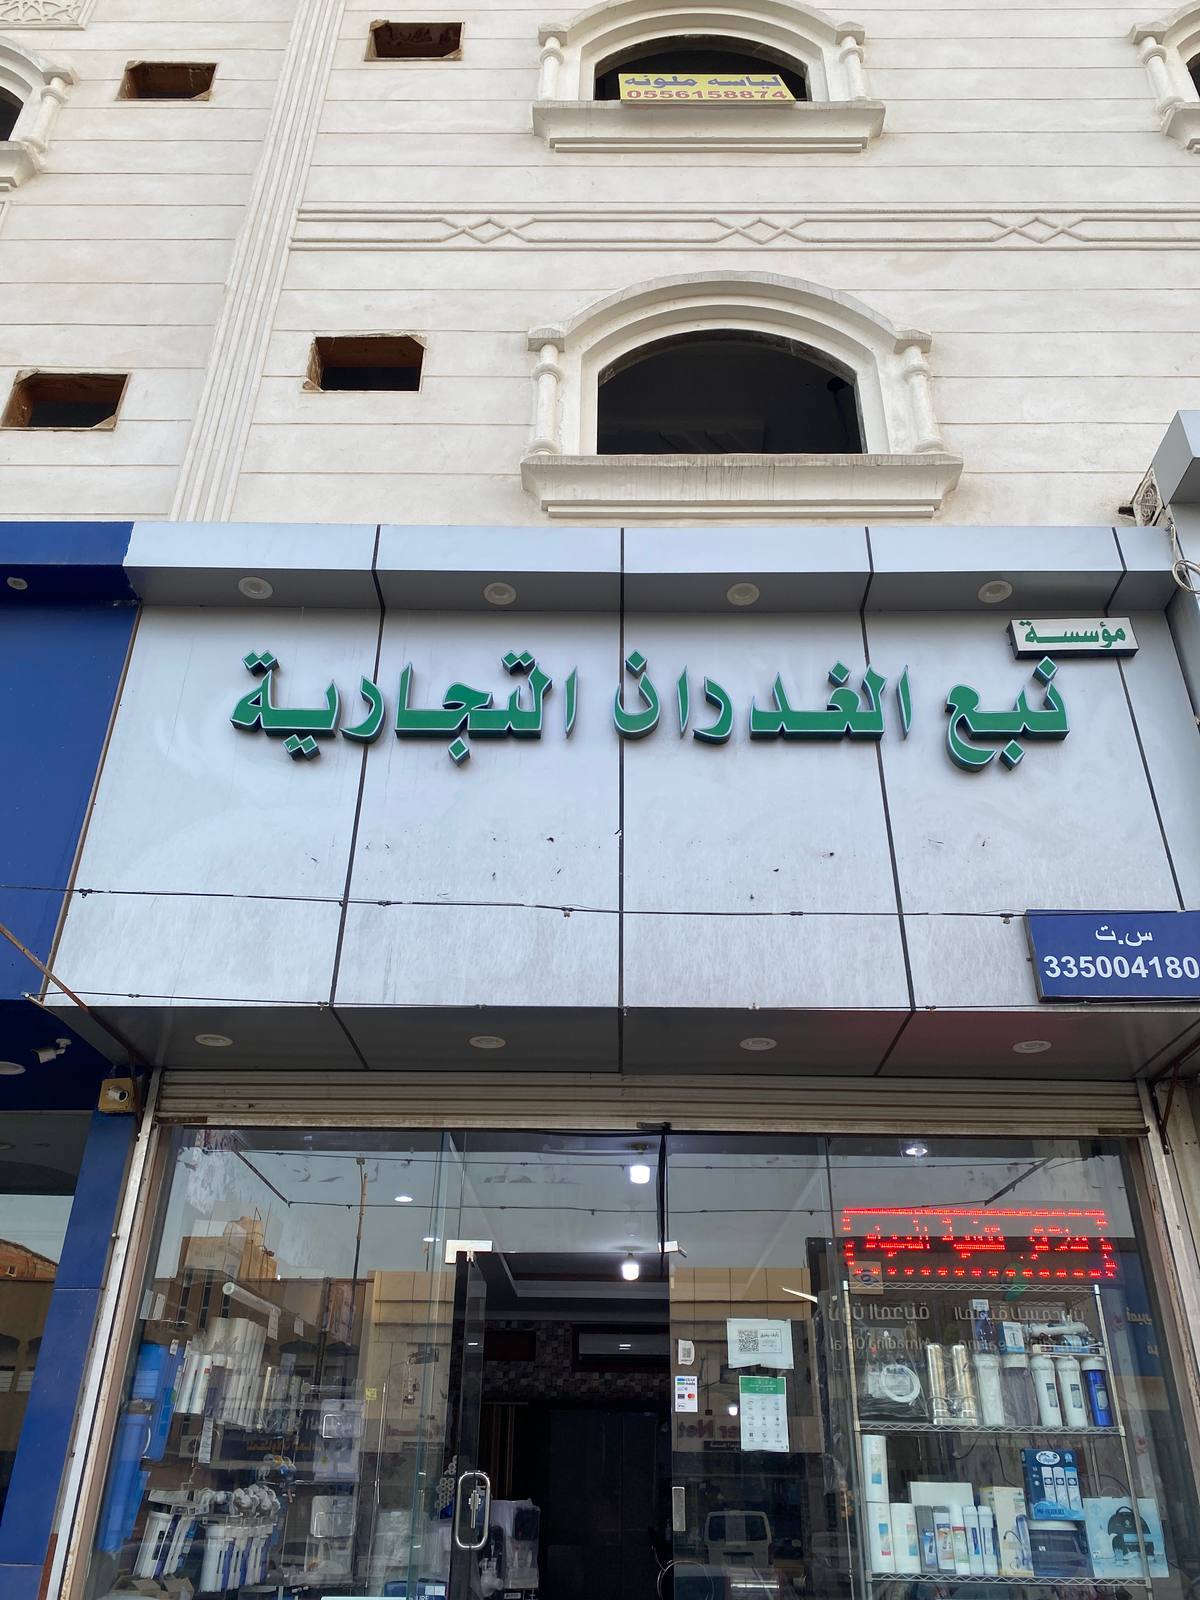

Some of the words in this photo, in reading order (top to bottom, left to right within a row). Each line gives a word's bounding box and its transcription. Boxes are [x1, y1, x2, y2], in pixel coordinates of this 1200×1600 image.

[624, 75, 697, 88] ملونه
[626, 90, 788, 99] 0556158874
[1018, 621, 1125, 648] مؤسسة
[230, 649, 579, 765] التجارية
[614, 649, 910, 743] الغدران
[946, 656, 1070, 770] نبع
[1095, 925, 1153, 946] س.ت
